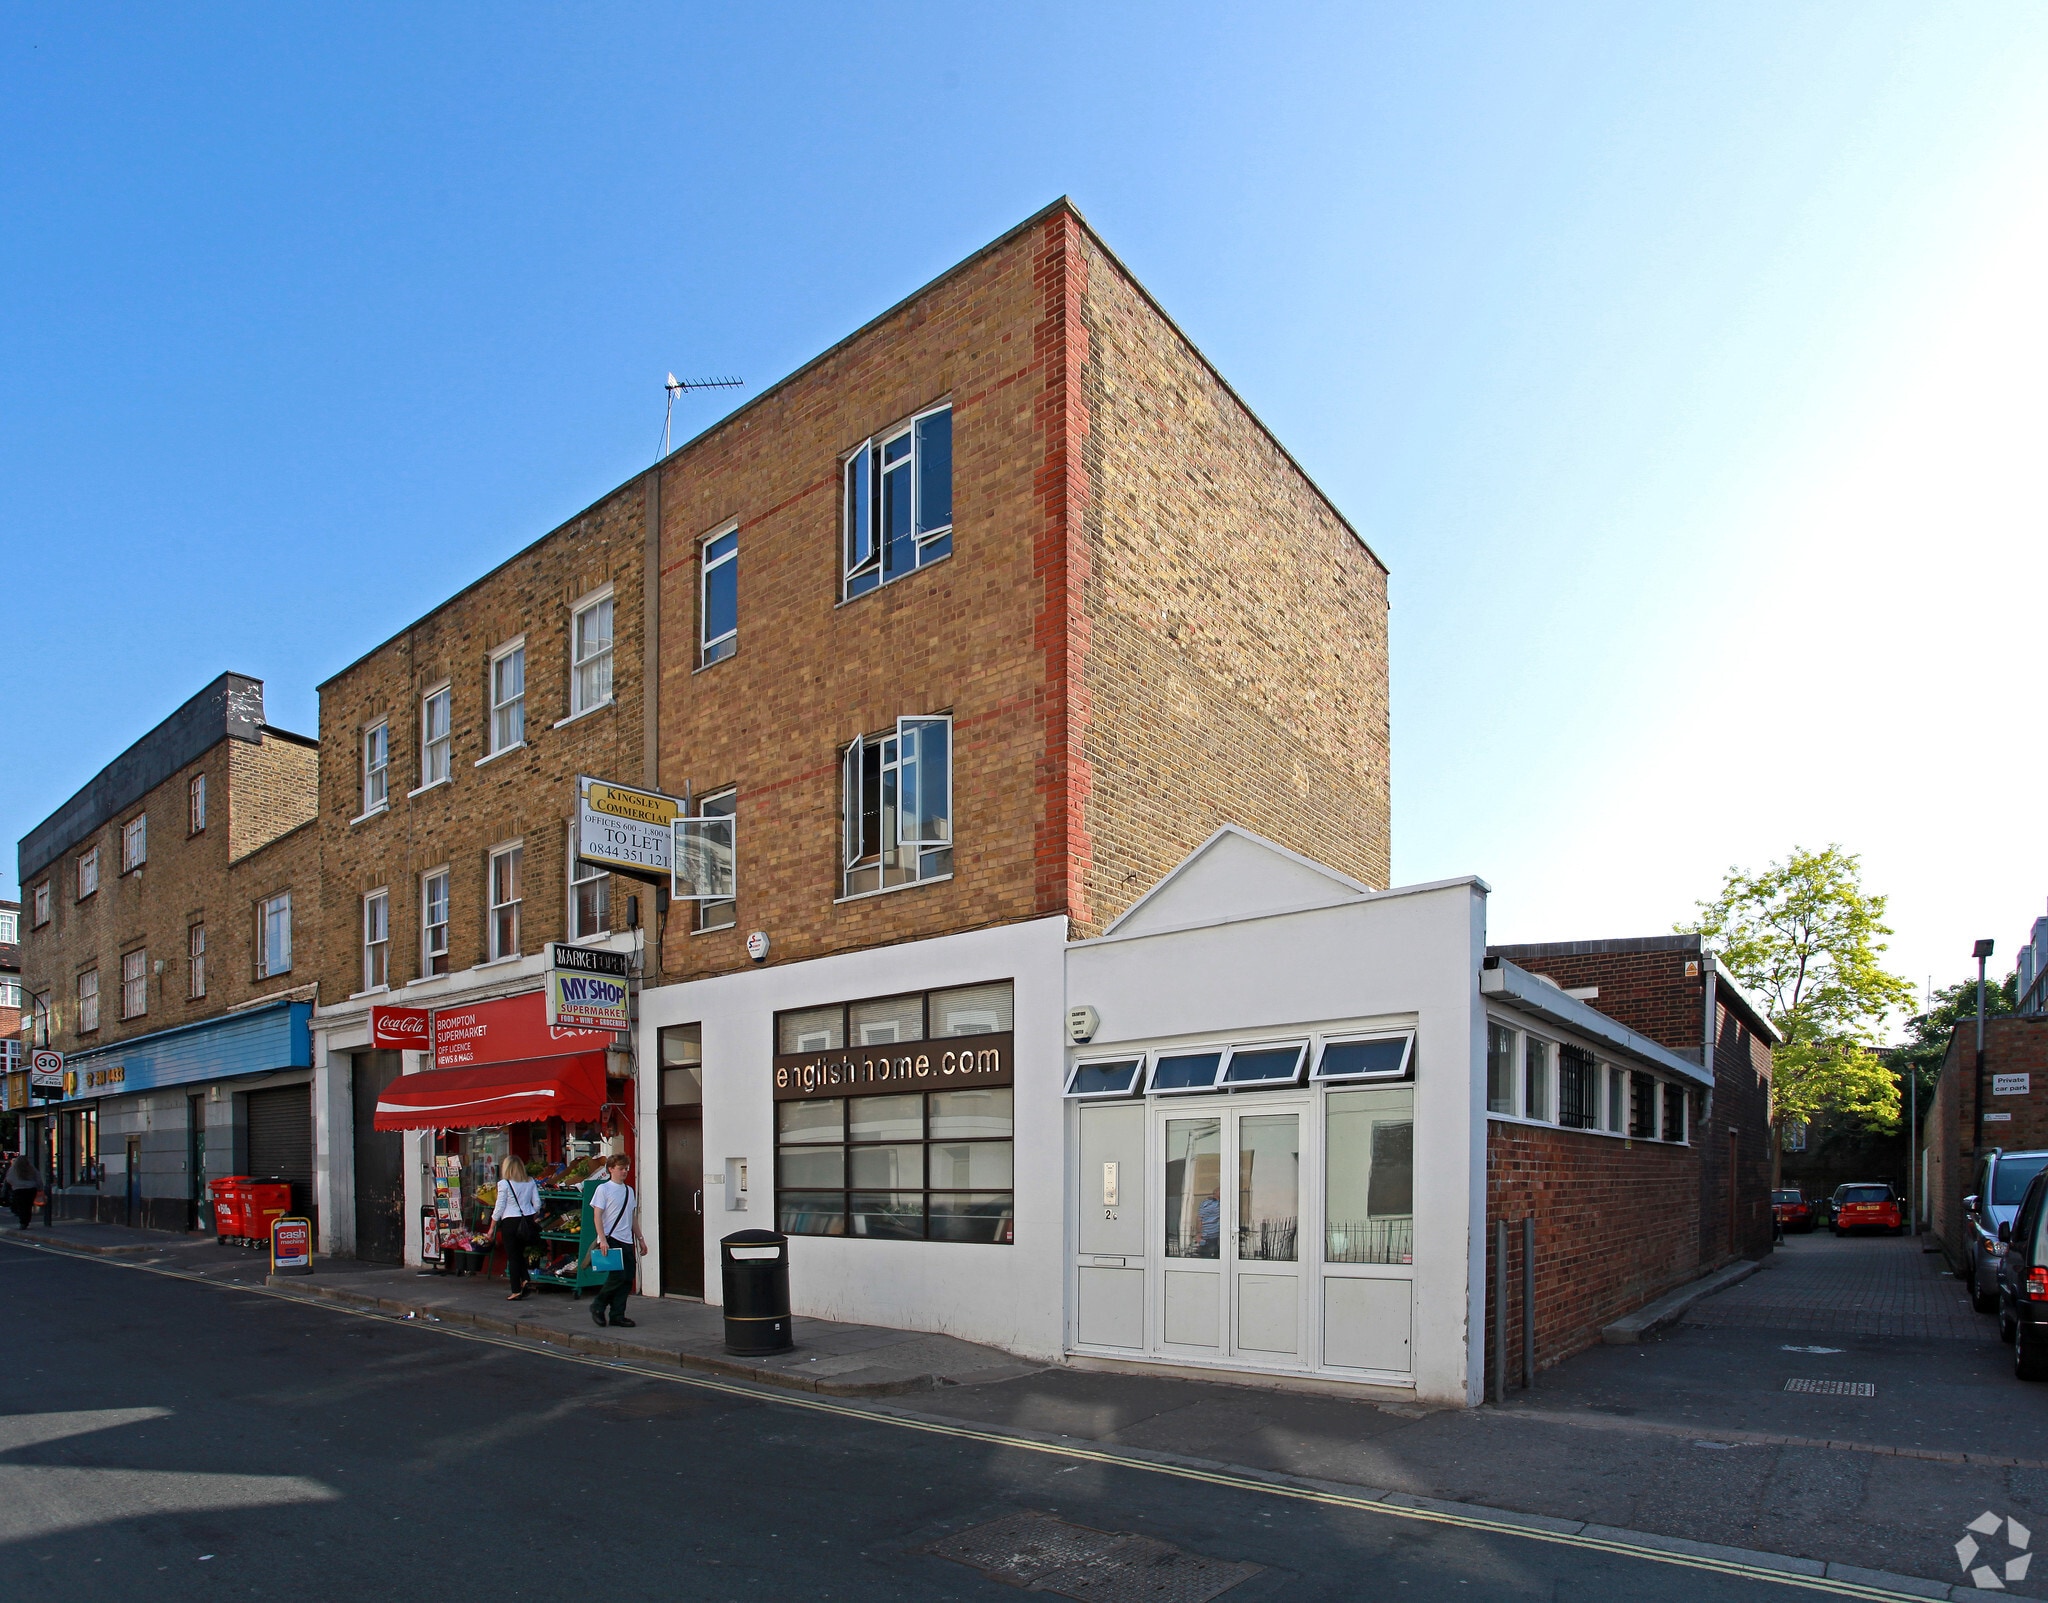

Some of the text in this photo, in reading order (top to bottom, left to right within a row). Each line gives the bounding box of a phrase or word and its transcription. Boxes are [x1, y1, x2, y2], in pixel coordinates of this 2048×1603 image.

[607, 788, 660, 810] KINGSLEY
[597, 799, 670, 824] COMMERCIAL
[584, 814, 621, 828] OFFICES
[622, 824, 637, 832] 600
[644, 827, 664, 837] 1,800
[604, 828, 662, 851] TO LET
[589, 841, 672, 868] 0844 351 121
[560, 977, 625, 1004] MY SHOP
[560, 1003, 627, 1018] SUPERMARKET
[437, 1014, 476, 1031] BROMPTON
[560, 1014, 627, 1028] FOOD WINE GROCERIES
[437, 1024, 488, 1043] SUPERMARKET
[438, 1042, 471, 1055] OFF LICENCE
[38, 1057, 58, 1068] 30
[438, 1052, 474, 1065] NEWS & MAGS
[776, 1047, 1000, 1093] english home.com
[279, 1228, 306, 1239] cash
